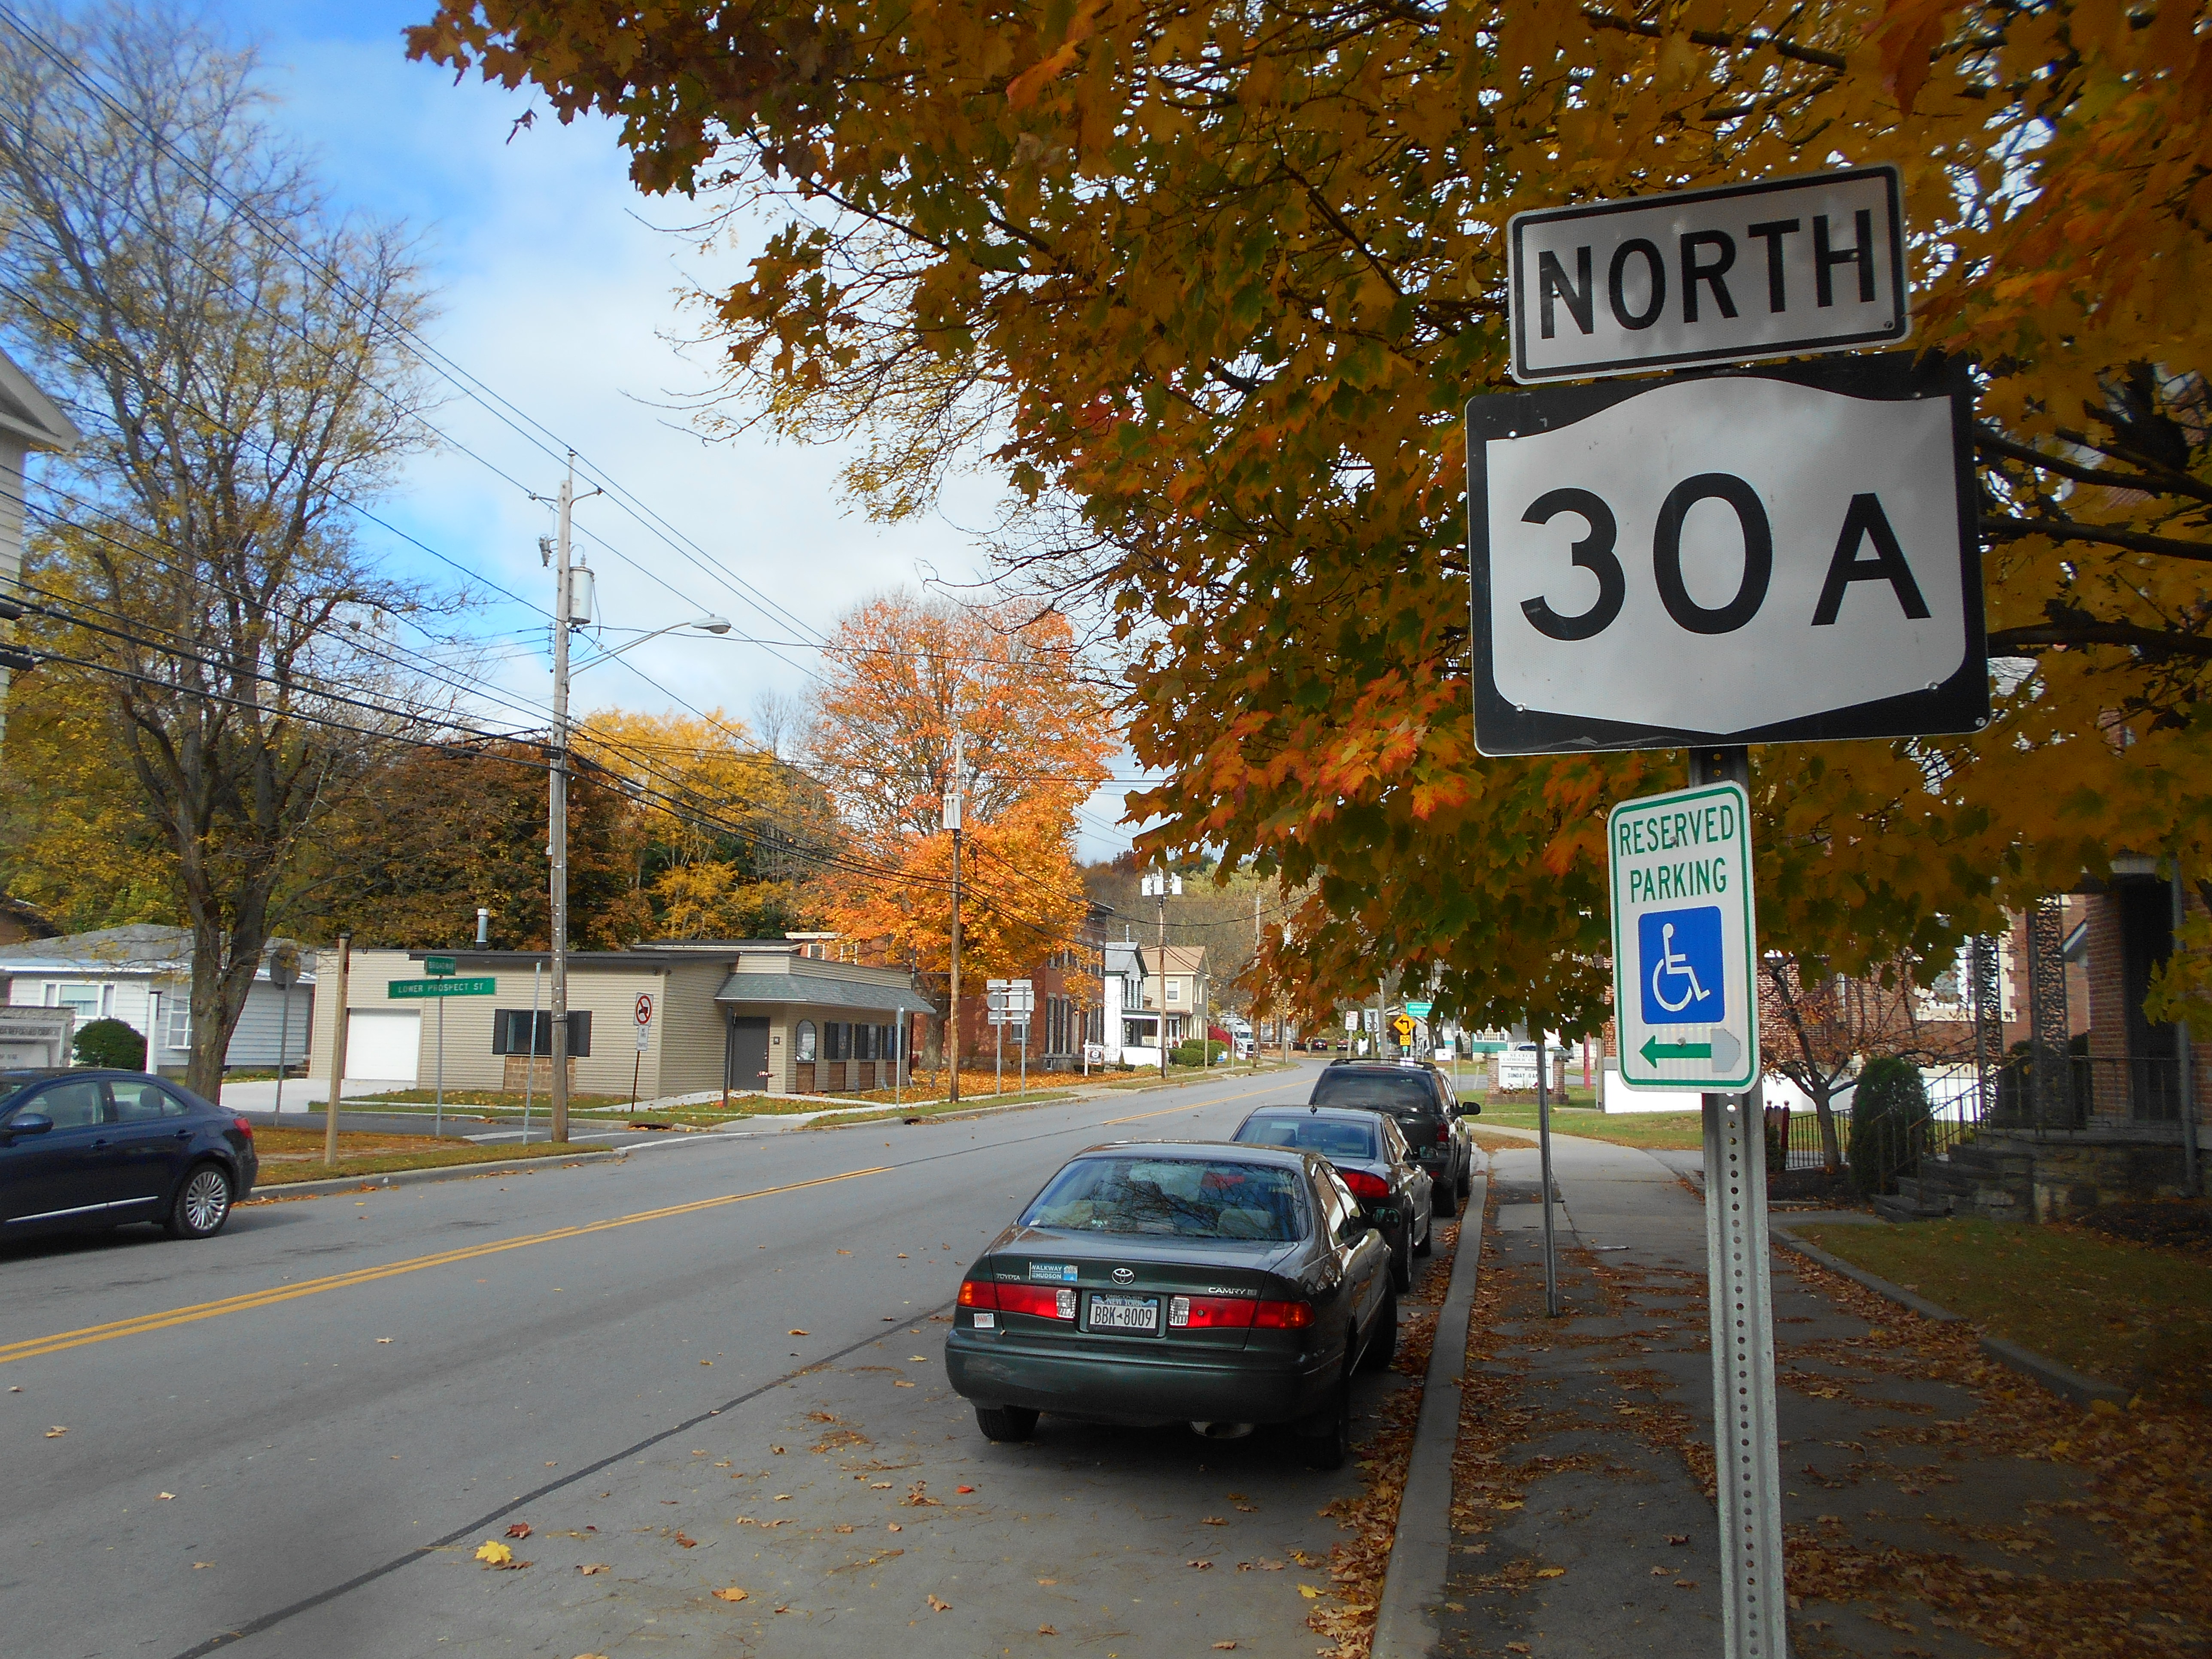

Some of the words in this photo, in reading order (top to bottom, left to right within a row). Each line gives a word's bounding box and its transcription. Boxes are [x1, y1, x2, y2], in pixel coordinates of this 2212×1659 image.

[1537, 209, 1876, 340] NORTH
[1620, 805, 1734, 856] RESERVED
[1630, 857, 1727, 903] PARKING
[398, 984, 423, 993] LOWER
[428, 983, 468, 992] PROSPECT
